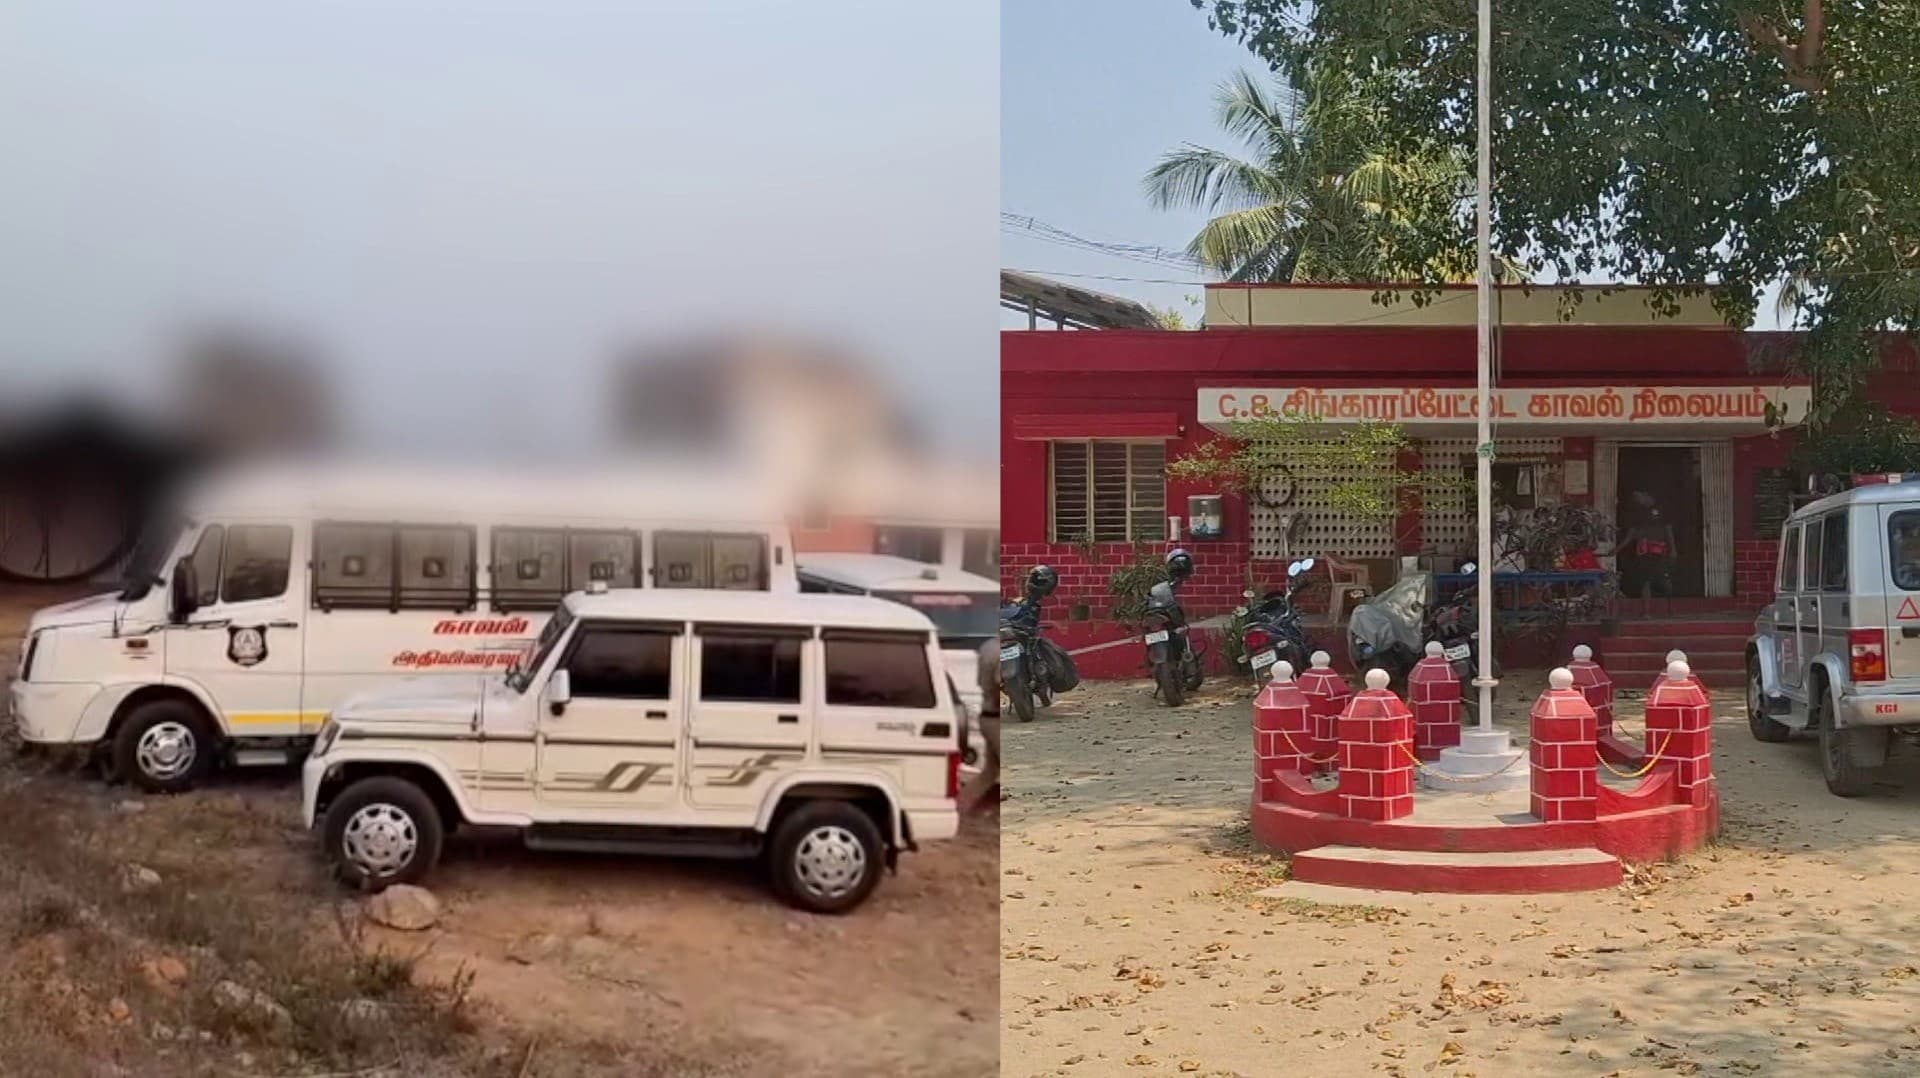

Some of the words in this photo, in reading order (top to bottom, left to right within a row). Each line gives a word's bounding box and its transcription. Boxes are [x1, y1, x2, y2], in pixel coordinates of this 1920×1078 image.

[1527, 387, 1625, 417] காவல்
[1629, 386, 1769, 421] நிலையம்
[432, 617, 529, 635] காவல்
